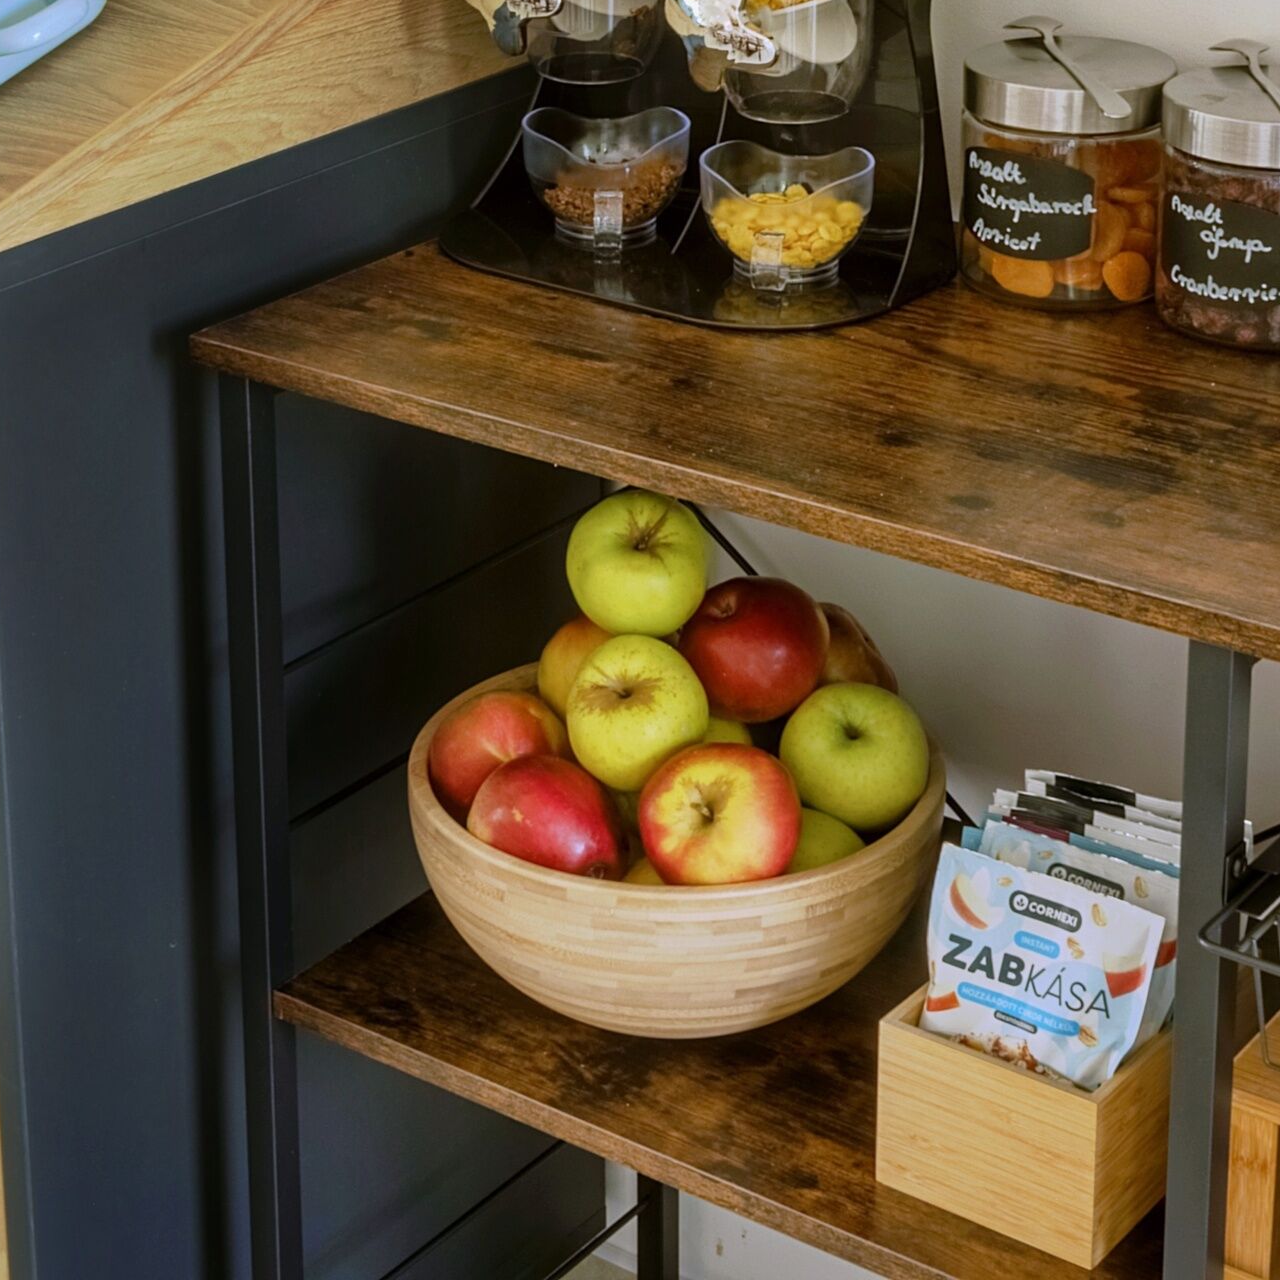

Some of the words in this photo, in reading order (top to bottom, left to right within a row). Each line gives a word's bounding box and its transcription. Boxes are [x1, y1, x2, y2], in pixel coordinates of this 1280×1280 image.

[972, 217, 1042, 251] Apricot
[1028, 902, 1079, 928] CORNEXI
[941, 933, 1111, 1019] ZABKÁSA
